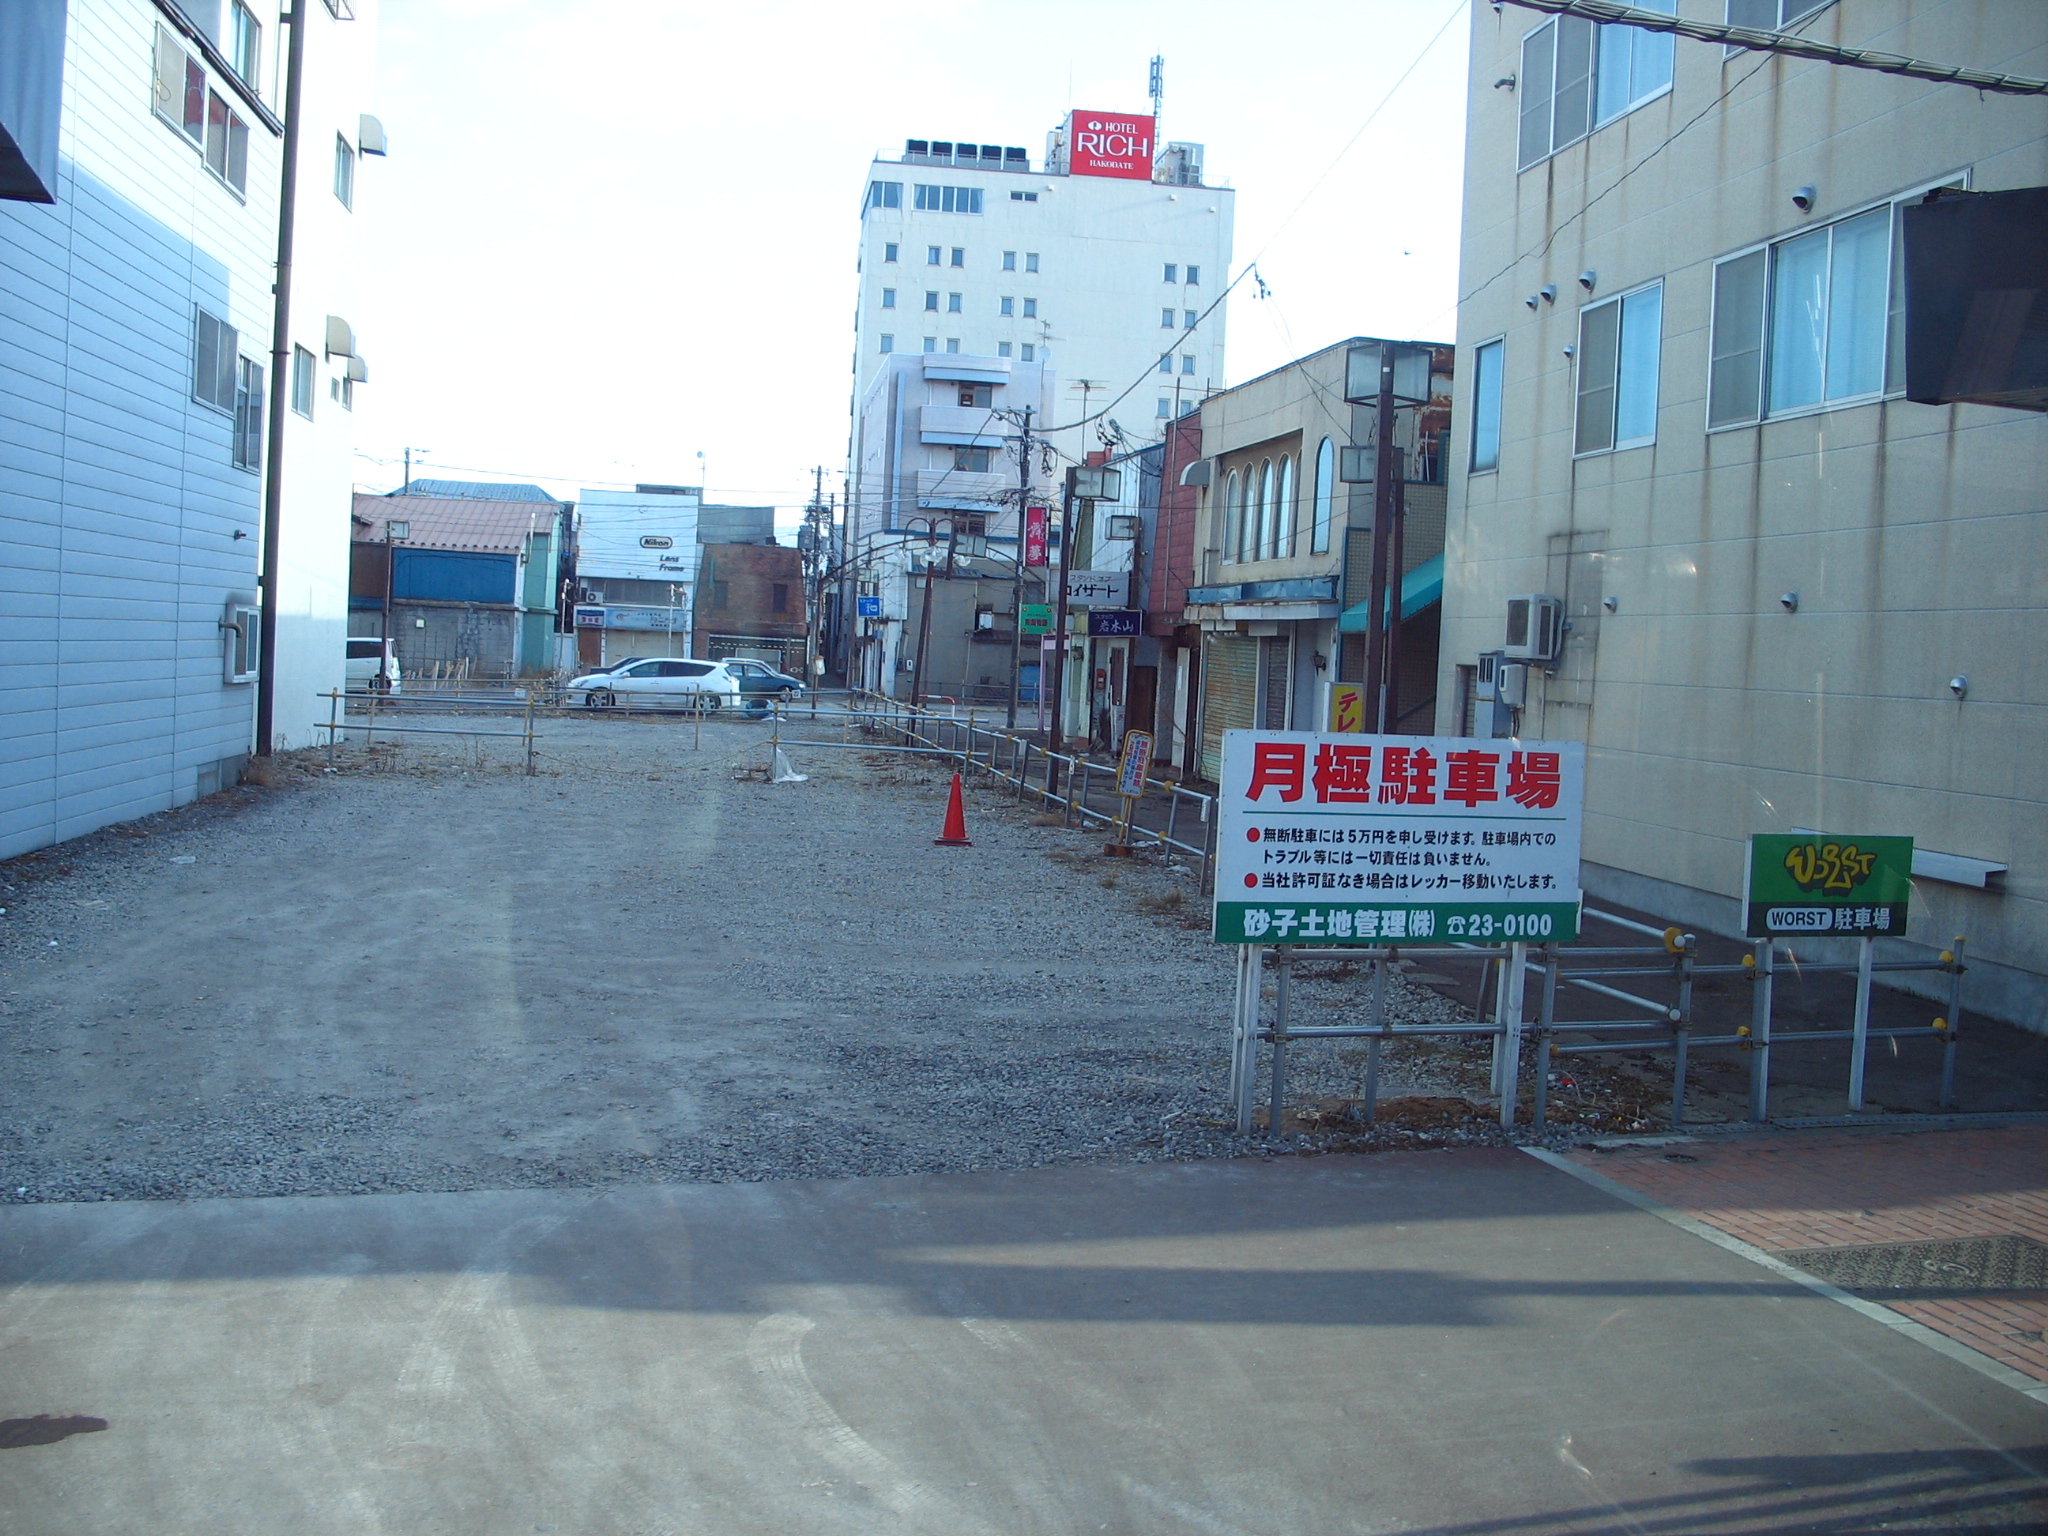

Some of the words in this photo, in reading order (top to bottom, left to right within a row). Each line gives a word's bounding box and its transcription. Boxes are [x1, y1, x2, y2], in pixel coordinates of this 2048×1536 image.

[1105, 121, 1139, 135] HOTEL
[1077, 132, 1149, 158] RICH
[1089, 159, 1134, 170] HAKODATE
[644, 538, 669, 546] Nikon
[660, 554, 679, 562] Lens
[659, 564, 684, 572] Frame
[1099, 619, 1134, 633] 岩木山
[1245, 742, 1562, 811] 月極駐車場
[1263, 849, 1491, 867] トラブル等には一切責任は負いません。
[1262, 872, 1557, 891] 当社許可証なき場合はレッカー移動いたします。
[1468, 914, 1552, 937] 23-0100
[1771, 911, 1827, 926] WORST
[1834, 907, 1891, 931] 駐車場
